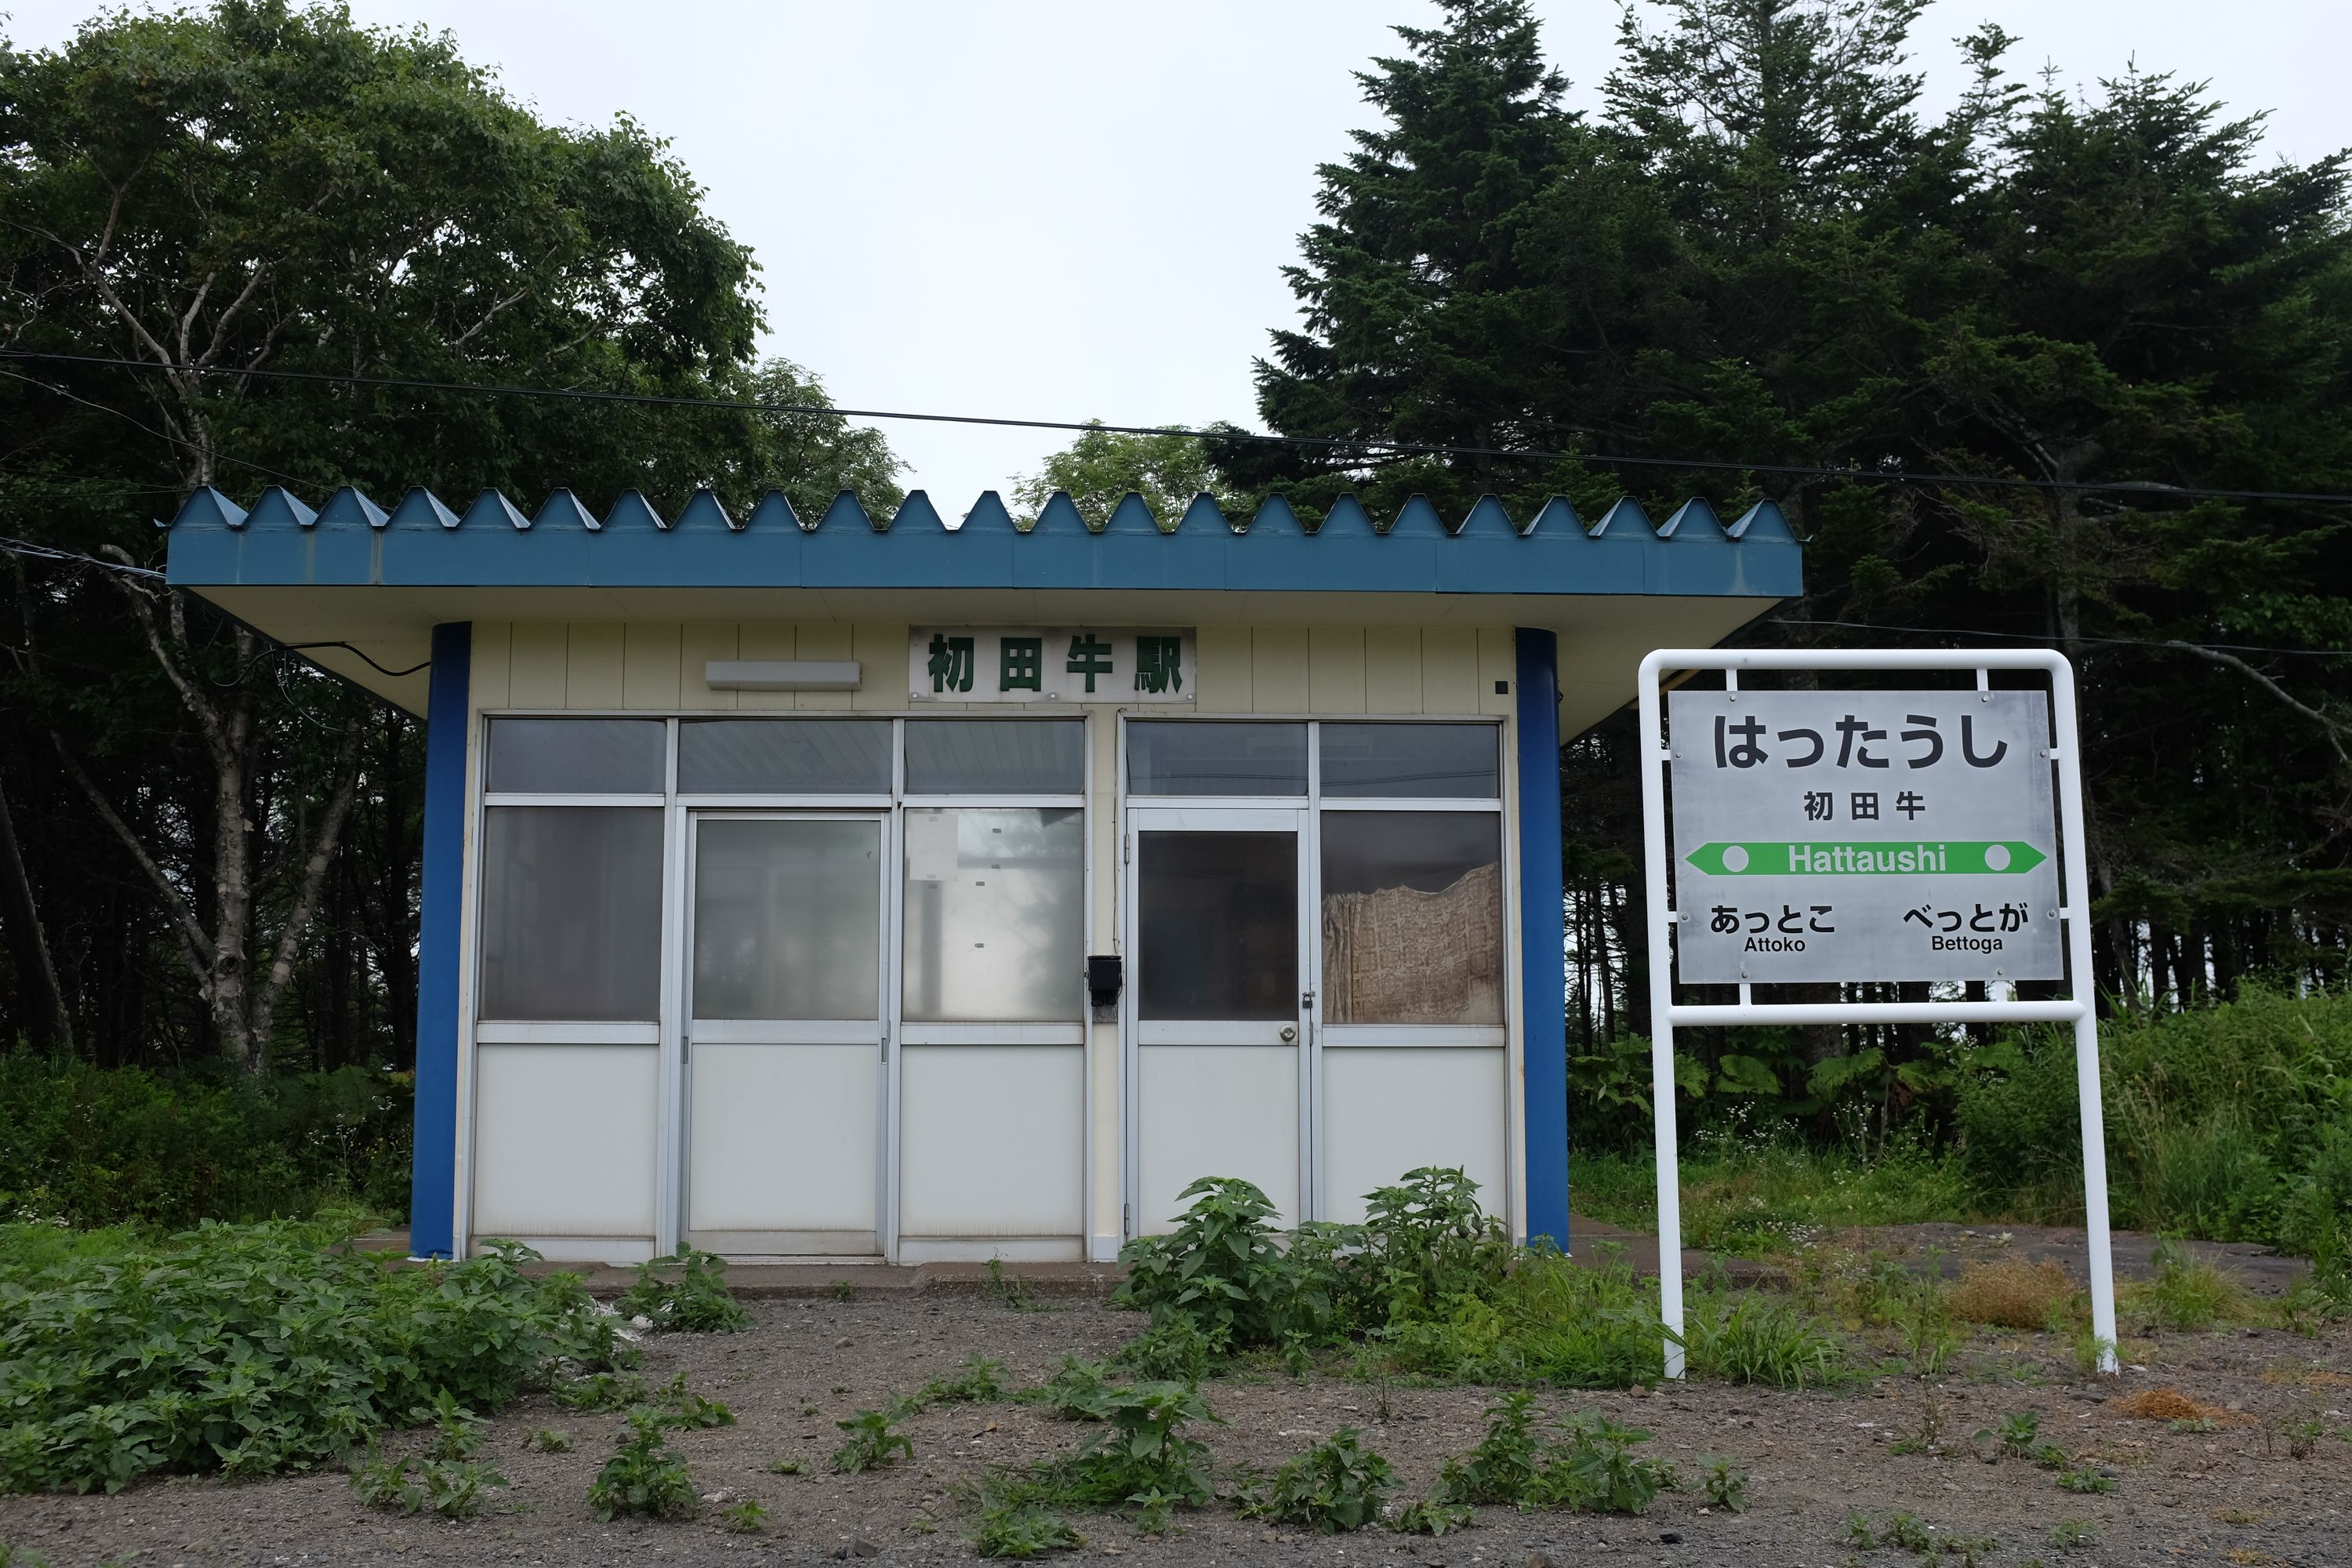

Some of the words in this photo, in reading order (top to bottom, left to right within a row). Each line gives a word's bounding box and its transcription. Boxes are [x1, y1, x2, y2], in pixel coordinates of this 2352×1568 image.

[927, 633, 1182, 693] 初田牛駅
[1714, 714, 2008, 769] はったうし
[1803, 790, 1926, 821] 初田牛
[1788, 844, 1946, 872] Hattaushi
[1710, 904, 1835, 935] あっとこ
[1903, 902, 2029, 933] べっとが
[1744, 936, 1806, 953] Attoko
[1931, 935, 2004, 954] Bettoga
